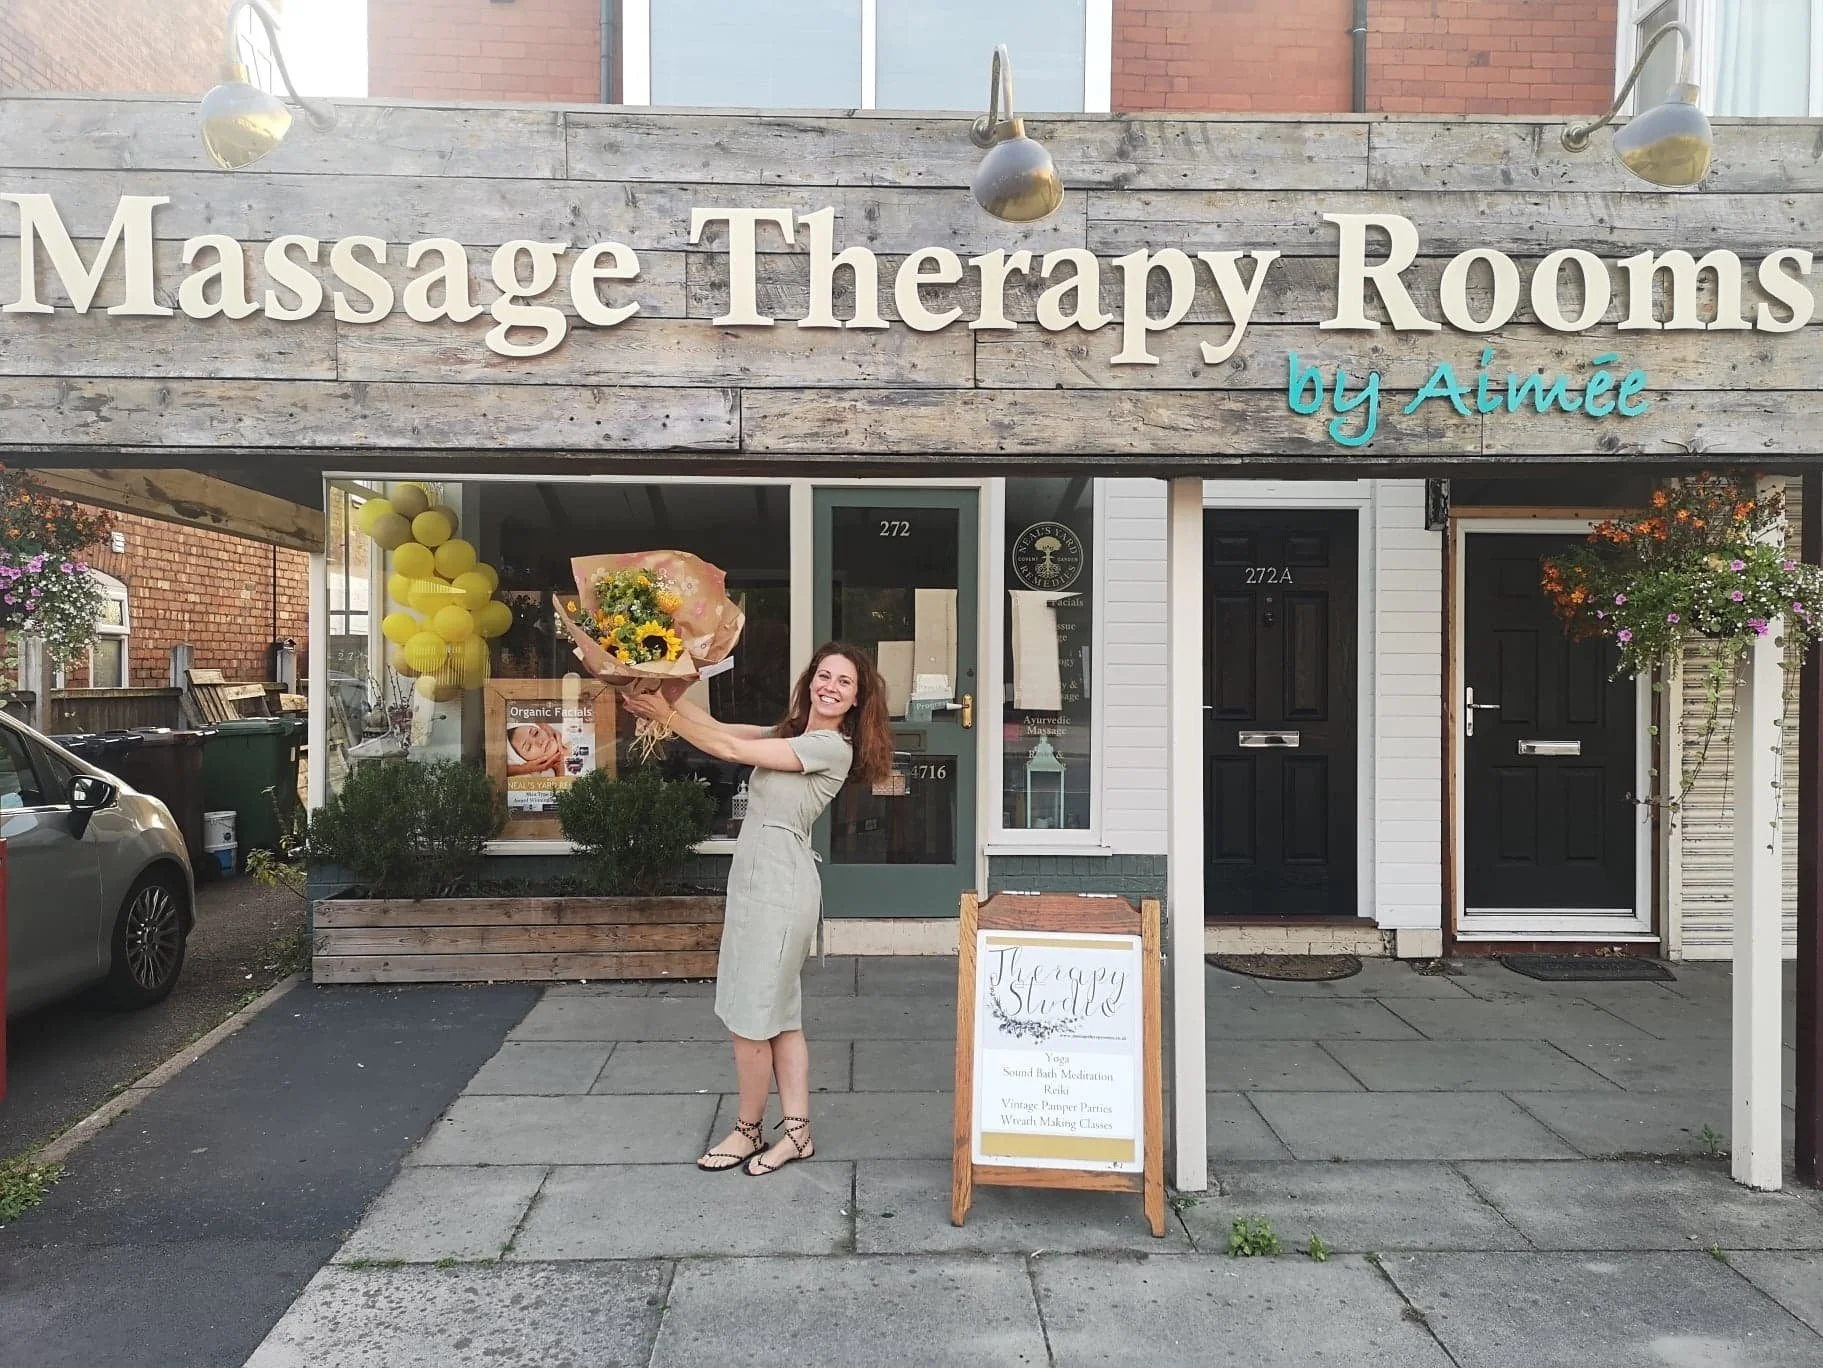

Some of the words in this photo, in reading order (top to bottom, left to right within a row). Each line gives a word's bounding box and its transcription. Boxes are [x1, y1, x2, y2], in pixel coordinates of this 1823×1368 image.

[0, 192, 642, 358] Massage
[688, 205, 1283, 365] Therapy
[1319, 212, 1816, 333] Rooms
[1288, 349, 1381, 447] by
[1402, 349, 1649, 417] Aimée
[879, 520, 911, 537] 272
[1055, 528, 1078, 554] YARD
[1020, 565, 1077, 588] REMEDIES
[1245, 566, 1294, 584] 272A
[510, 706, 551, 719] Organic
[554, 707, 592, 717] Facials
[1023, 714, 1071, 726] Ayurvedic
[1027, 725, 1067, 737] Massage
[989, 947, 1126, 1004] Therapy
[1007, 976, 1117, 1017] Studio
[1045, 1052, 1070, 1066] Yoga
[1002, 1066, 1033, 1078] Sound
[1036, 1068, 1057, 1079] Bath
[1060, 1069, 1114, 1081] Meditation
[1044, 1084, 1069, 1096] Reiki
[1001, 1098, 1039, 1112] Vintage
[1041, 1100, 1078, 1115] Pamper
[1080, 1103, 1112, 1114] Parties
[1001, 1115, 1037, 1127] Wreath
[1039, 1116, 1077, 1132] Making
[1079, 1118, 1113, 1130] Classes
